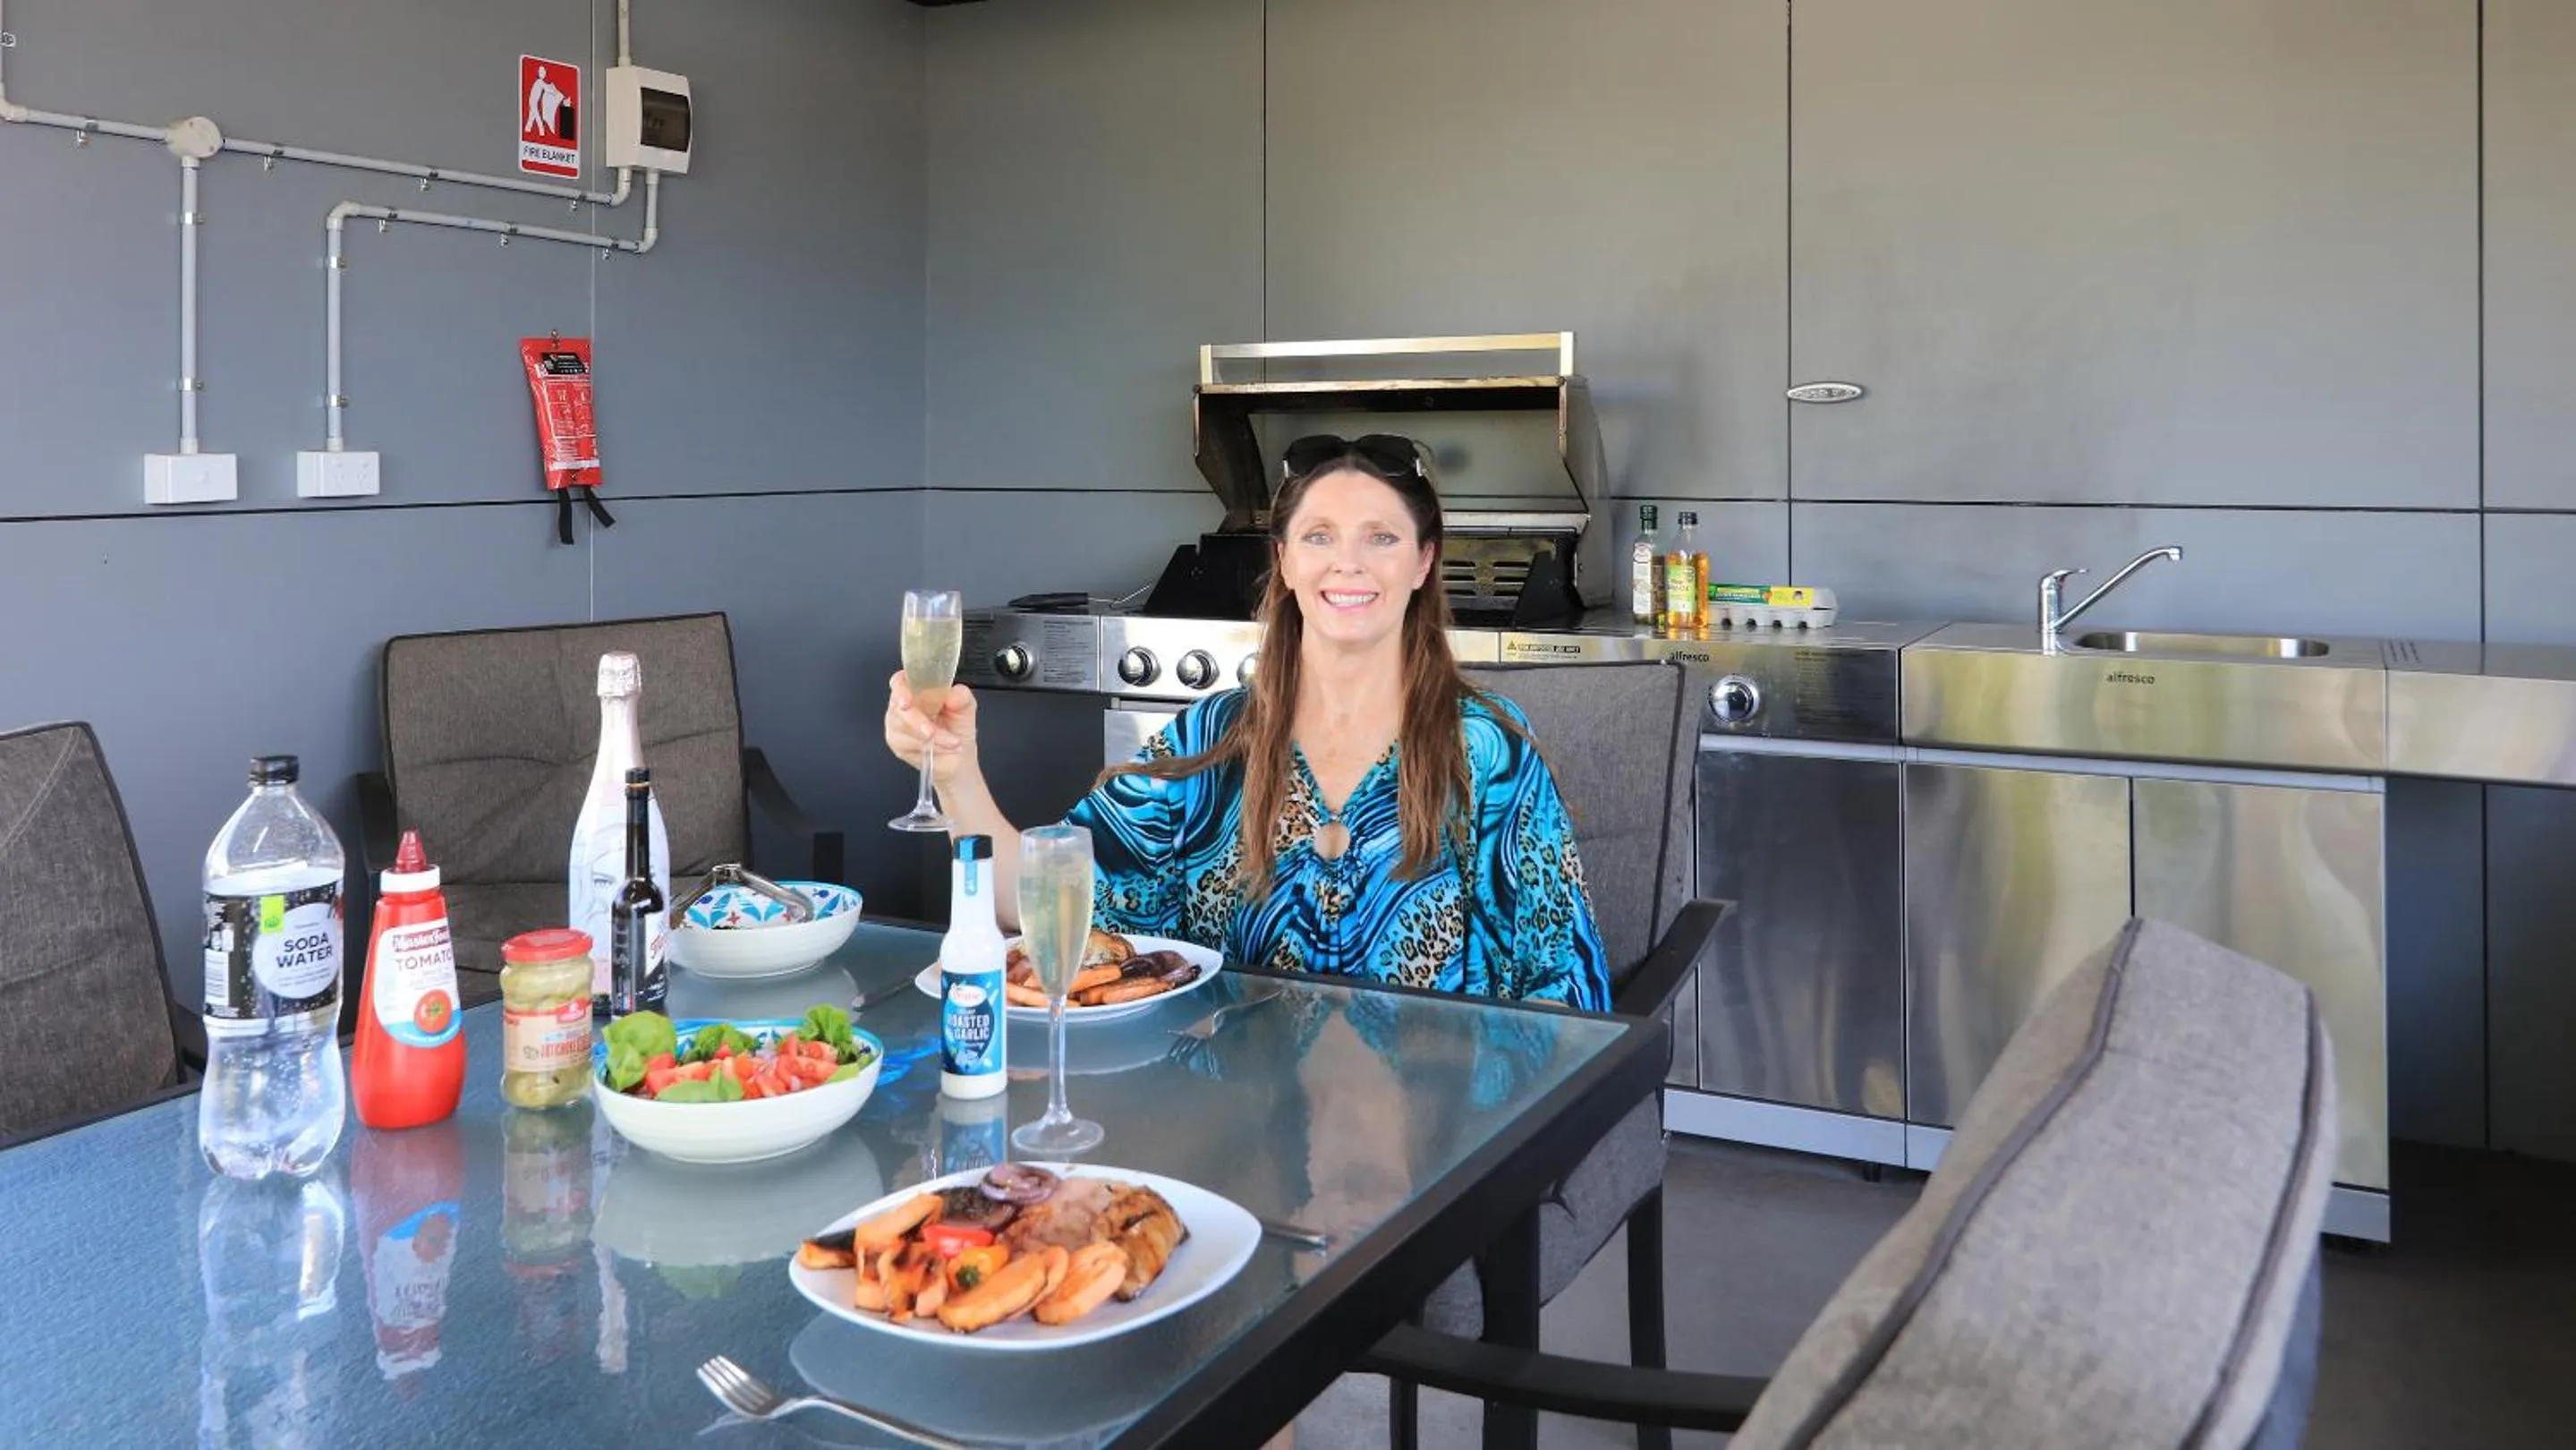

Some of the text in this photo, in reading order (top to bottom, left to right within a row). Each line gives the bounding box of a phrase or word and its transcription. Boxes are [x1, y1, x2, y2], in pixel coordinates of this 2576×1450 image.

[523, 145, 575, 164] FIRE BLANKET
[1671, 651, 1710, 662] alfresco
[2106, 670, 2155, 685] alfresco
[284, 931, 329, 952] SODA
[276, 944, 333, 968] WATER
[395, 948, 453, 971] TOMATO
[955, 1028, 990, 1041] GARLIC
